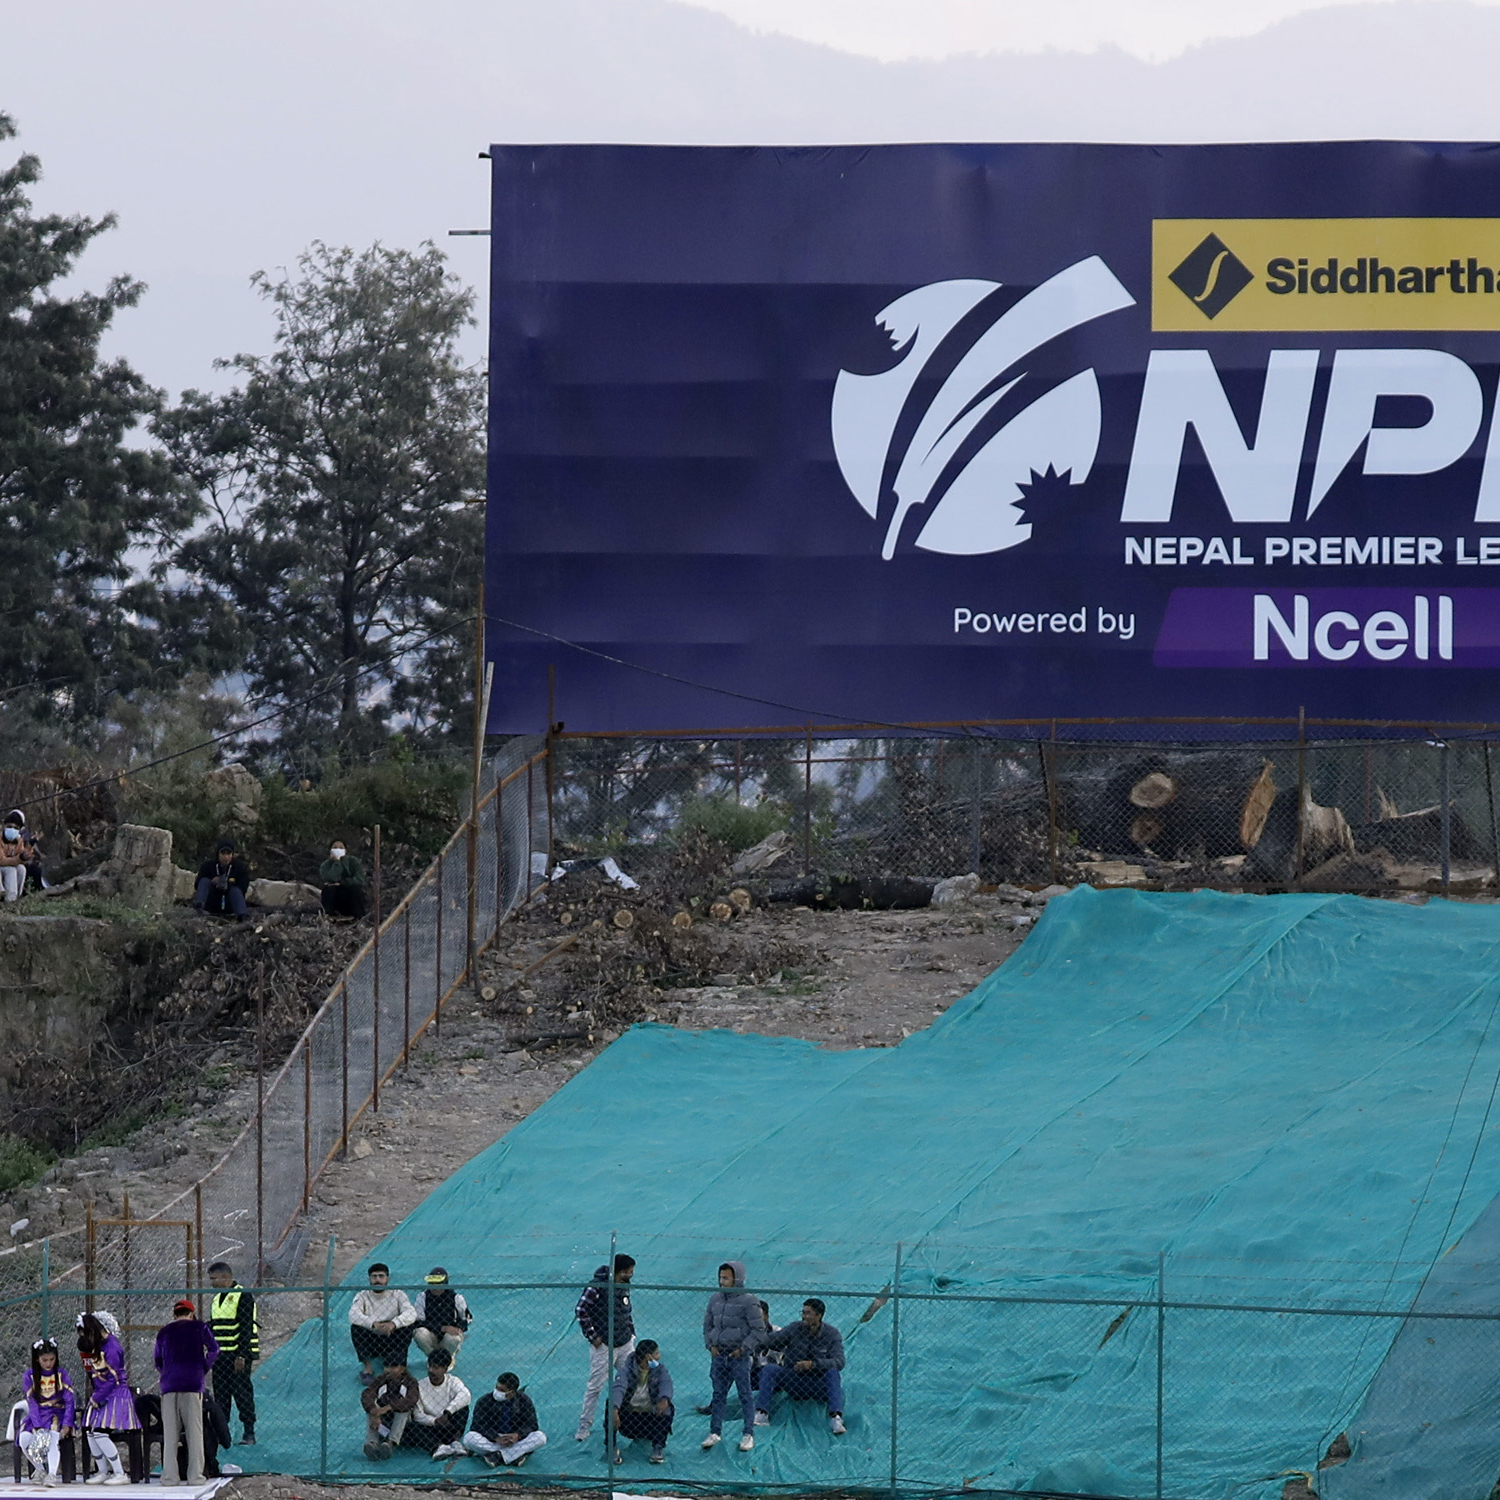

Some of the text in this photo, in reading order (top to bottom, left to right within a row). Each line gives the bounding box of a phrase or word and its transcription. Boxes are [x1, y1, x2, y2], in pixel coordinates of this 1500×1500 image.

[1124, 536, 1255, 566] NEPAL
[1264, 536, 1444, 566] PREMIER
[952, 607, 1137, 640] Powered by
[1253, 595, 1453, 661] Ncell
